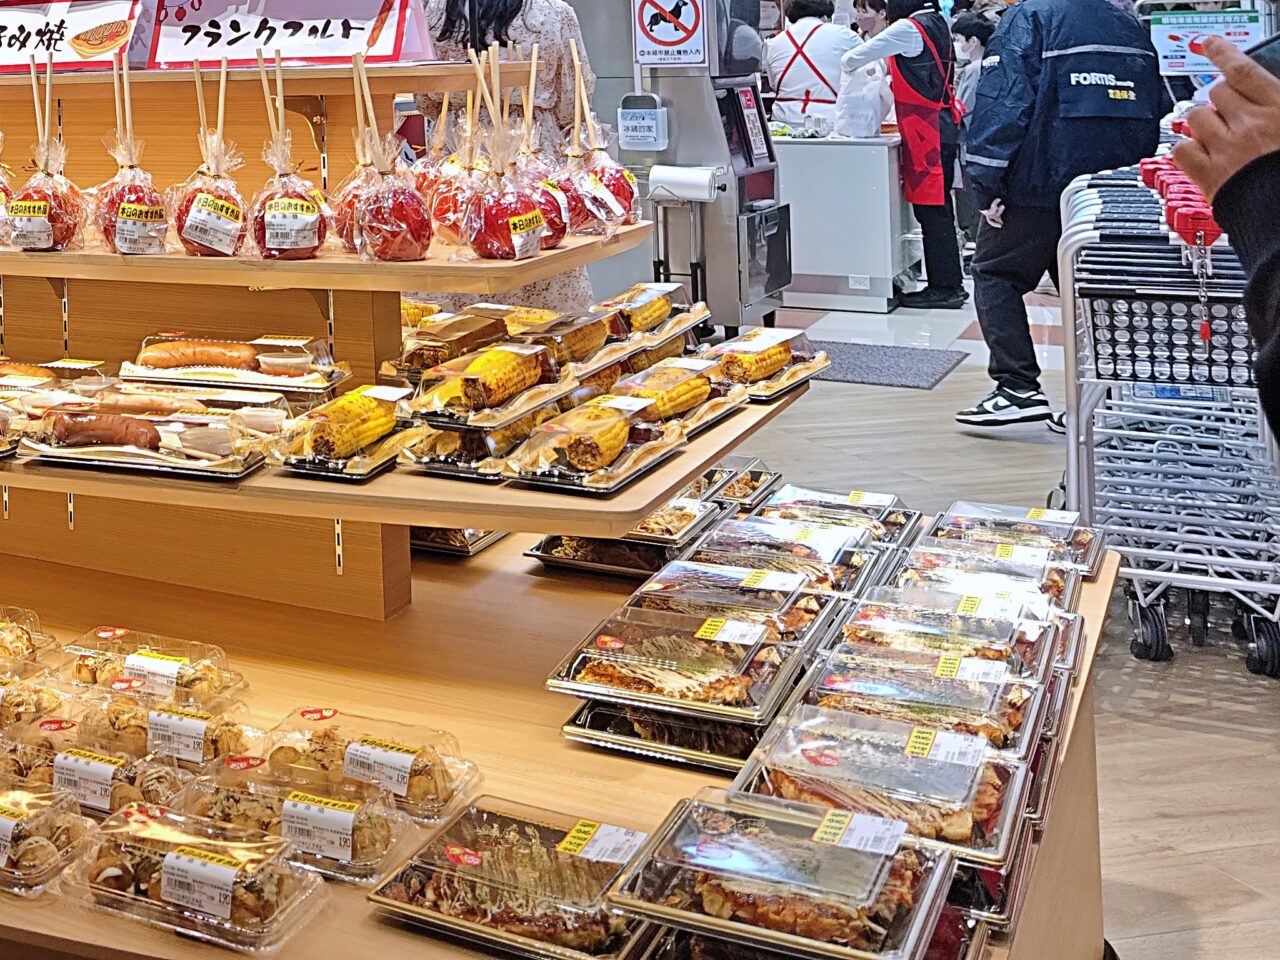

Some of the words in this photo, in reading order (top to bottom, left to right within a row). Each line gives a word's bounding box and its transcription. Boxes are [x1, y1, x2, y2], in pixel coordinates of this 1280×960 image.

[181, 19, 366, 46] フランクフルト
[1070, 72, 1116, 86] FORTIS
[192, 740, 203, 750] 190
[396, 773, 408, 785] 190
[100, 786, 110, 798] 190
[338, 836, 351, 848] 190
[218, 892, 231, 905] 190
